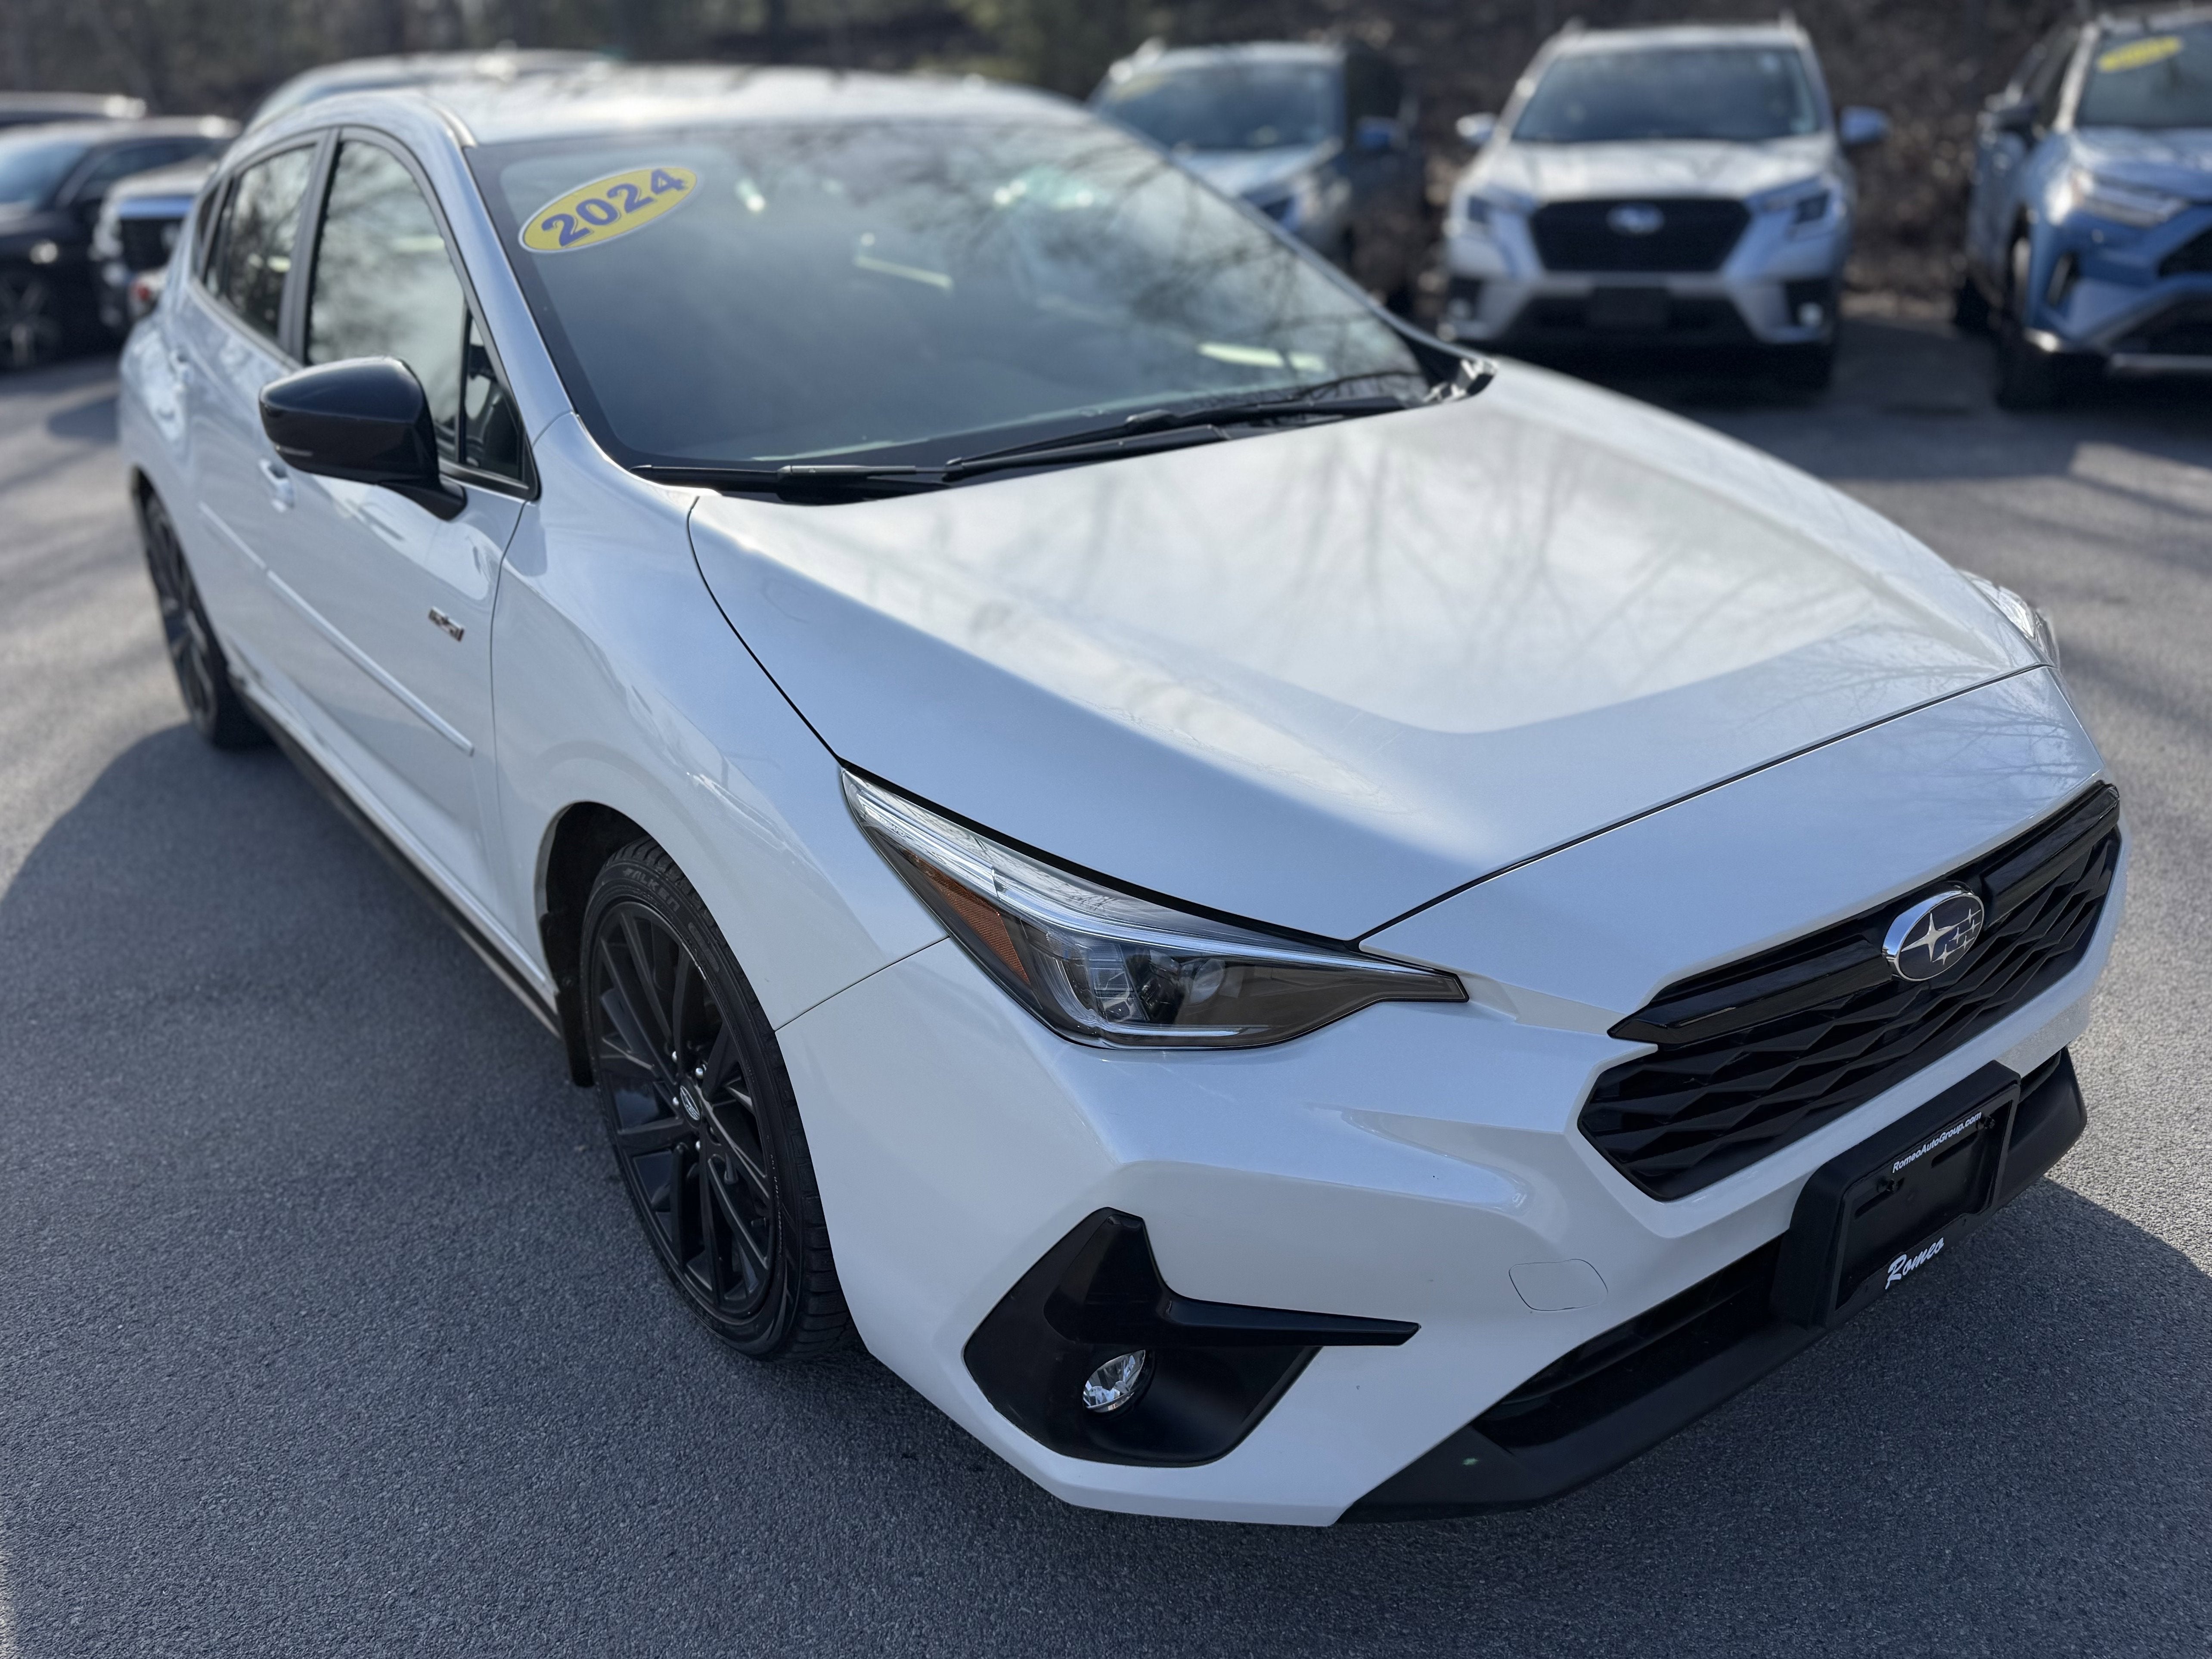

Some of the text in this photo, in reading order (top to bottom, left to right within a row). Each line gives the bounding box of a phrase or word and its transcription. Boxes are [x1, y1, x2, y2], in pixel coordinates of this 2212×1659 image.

[541, 168, 686, 247] 2024
[1892, 1112, 1982, 1173] RomeoAutoGroup.com
[1885, 1237, 1944, 1290] Romeo
